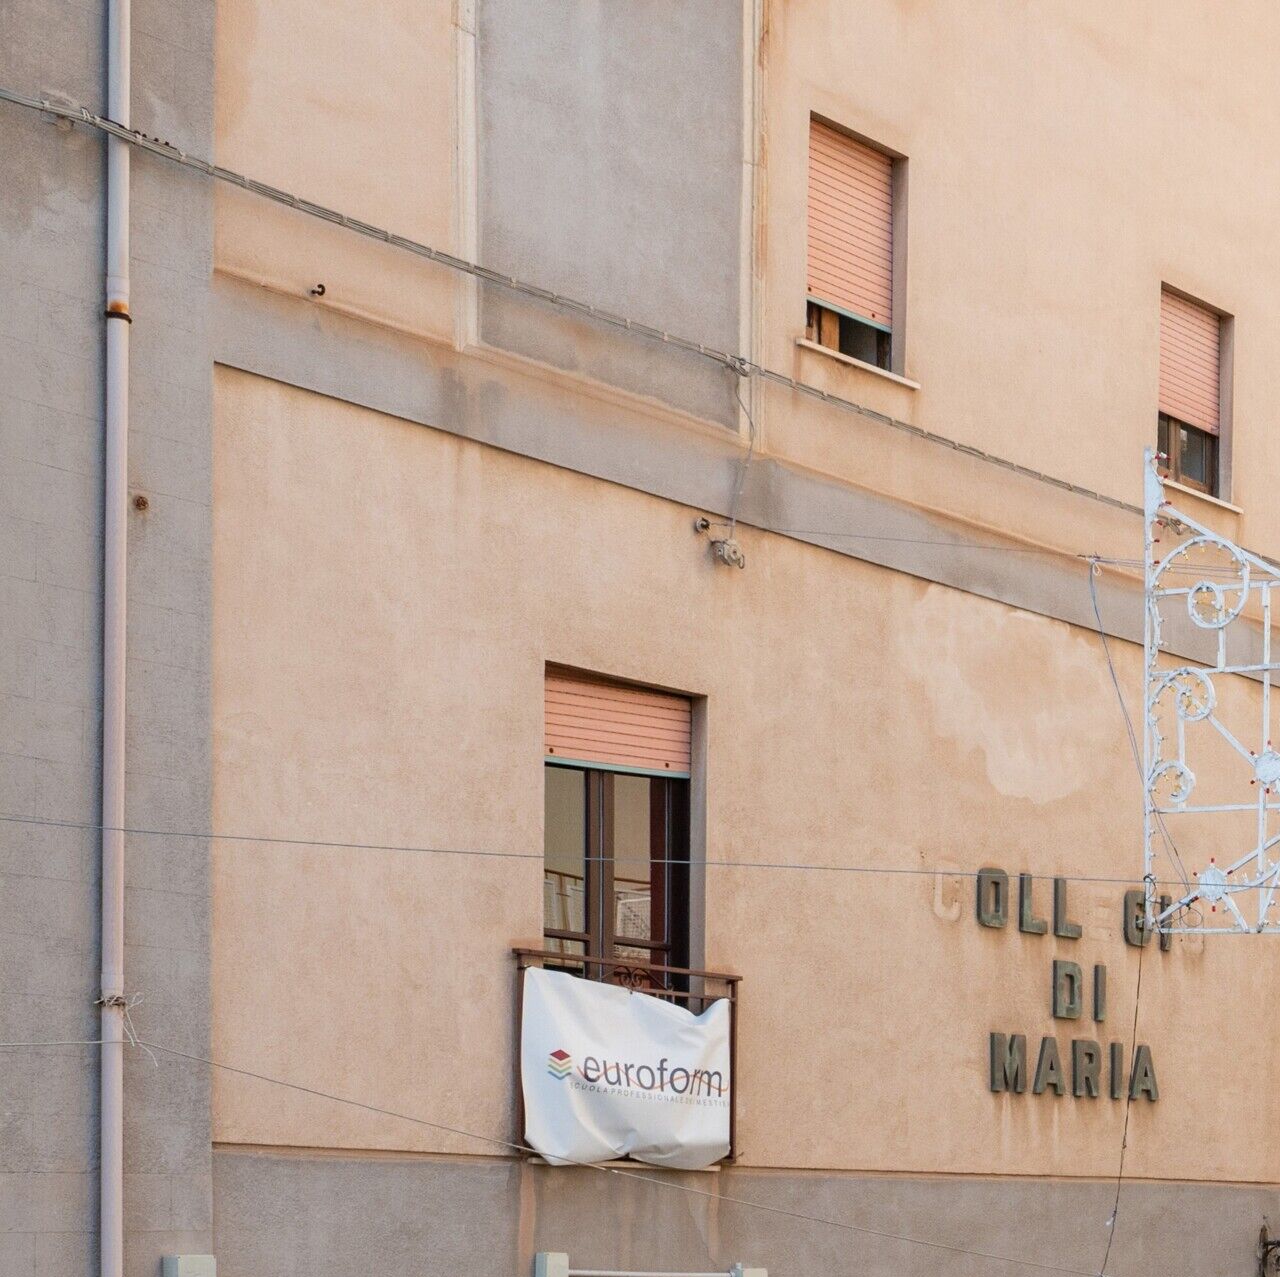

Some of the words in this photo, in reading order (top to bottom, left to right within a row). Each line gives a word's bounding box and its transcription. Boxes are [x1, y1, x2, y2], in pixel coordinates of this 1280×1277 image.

[1053, 960, 1106, 1022] DI
[584, 1056, 723, 1098] euroform
[990, 1032, 1158, 1101] MARIA
